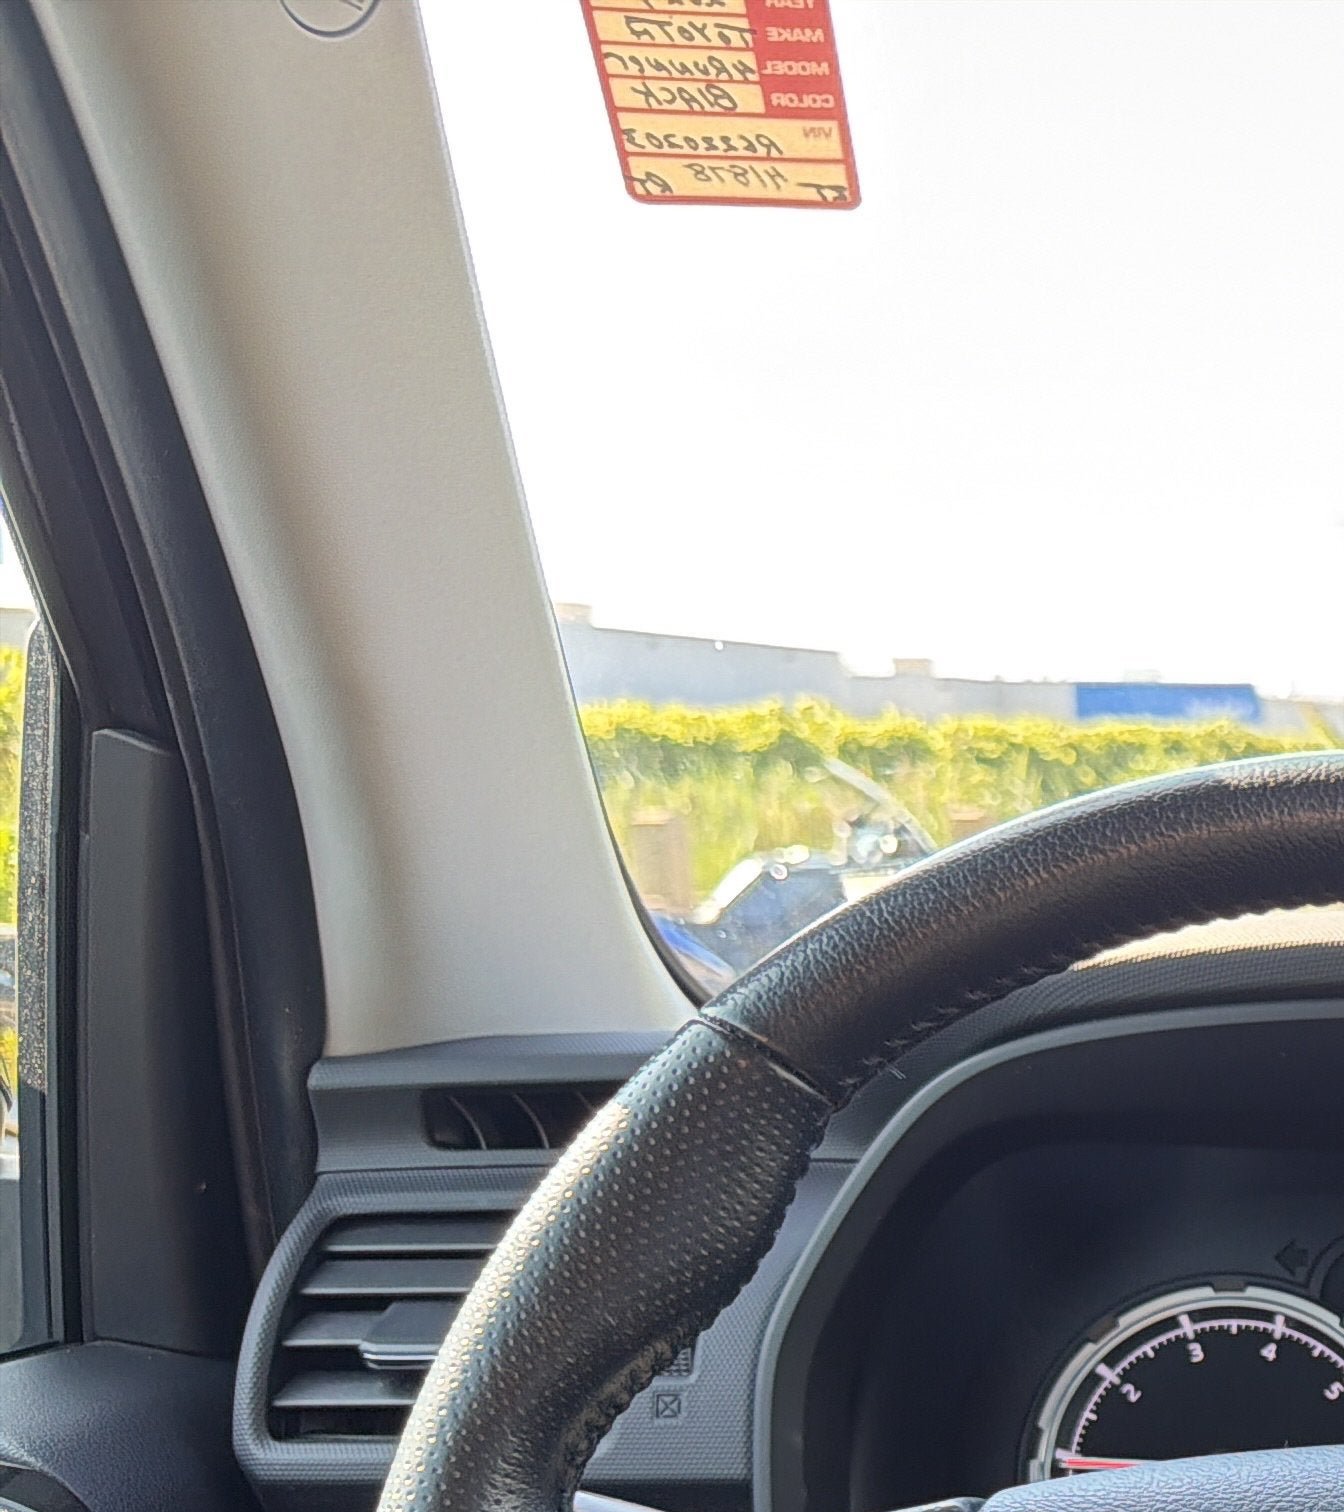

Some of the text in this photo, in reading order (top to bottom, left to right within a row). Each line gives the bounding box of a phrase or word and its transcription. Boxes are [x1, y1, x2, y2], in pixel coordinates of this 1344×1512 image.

[1187, 1342, 1204, 1363] 3
[1260, 1342, 1277, 1361] 4
[1121, 1383, 1141, 1402] 2
[1323, 1381, 1344, 1400] 5
